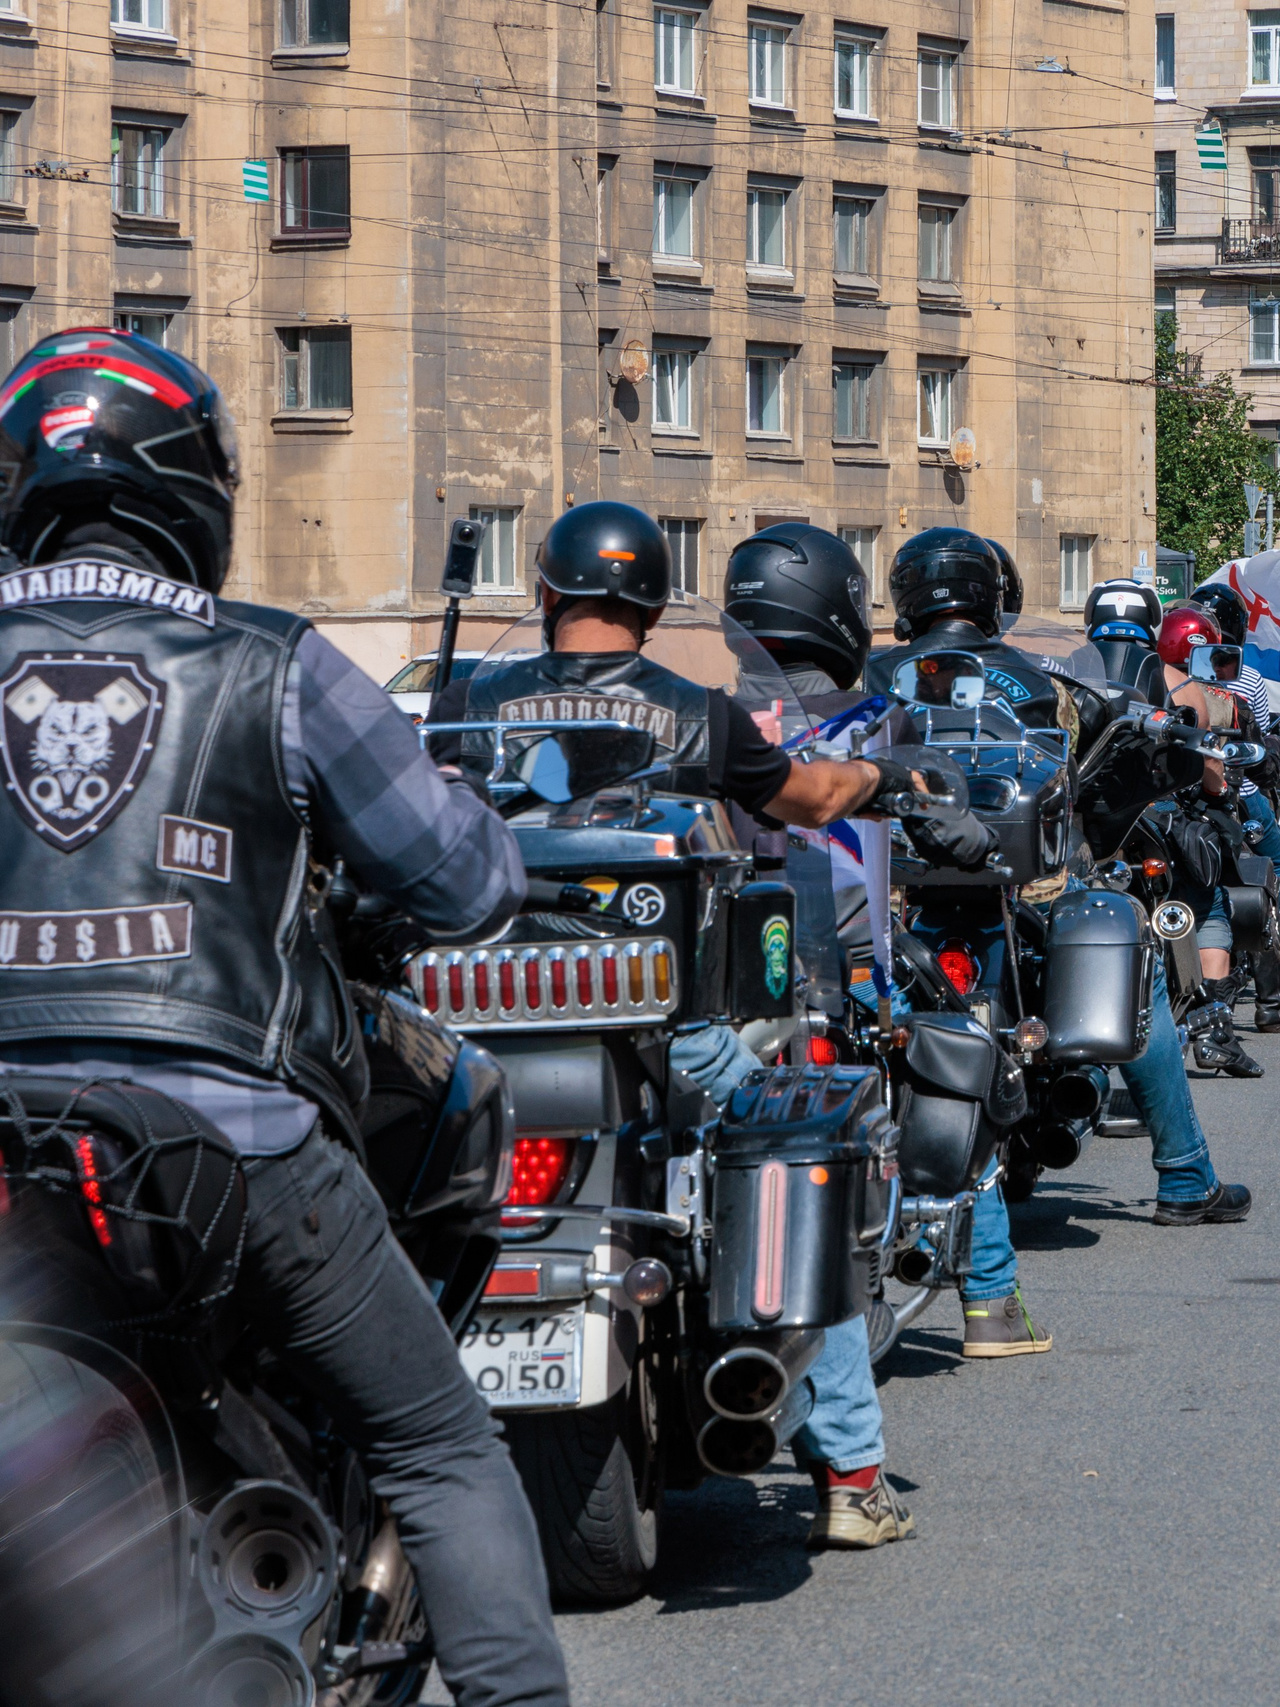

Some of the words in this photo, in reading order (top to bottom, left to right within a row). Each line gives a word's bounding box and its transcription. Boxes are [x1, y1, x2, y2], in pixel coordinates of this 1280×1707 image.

[0, 562, 208, 614] UARDSMEN
[730, 581, 765, 591] LS2
[829, 614, 859, 649] LS2
[173, 825, 217, 870] MC
[0, 910, 175, 964] USSIA
[508, 1350, 540, 1362] RUS
[518, 1363, 566, 1391] 50
